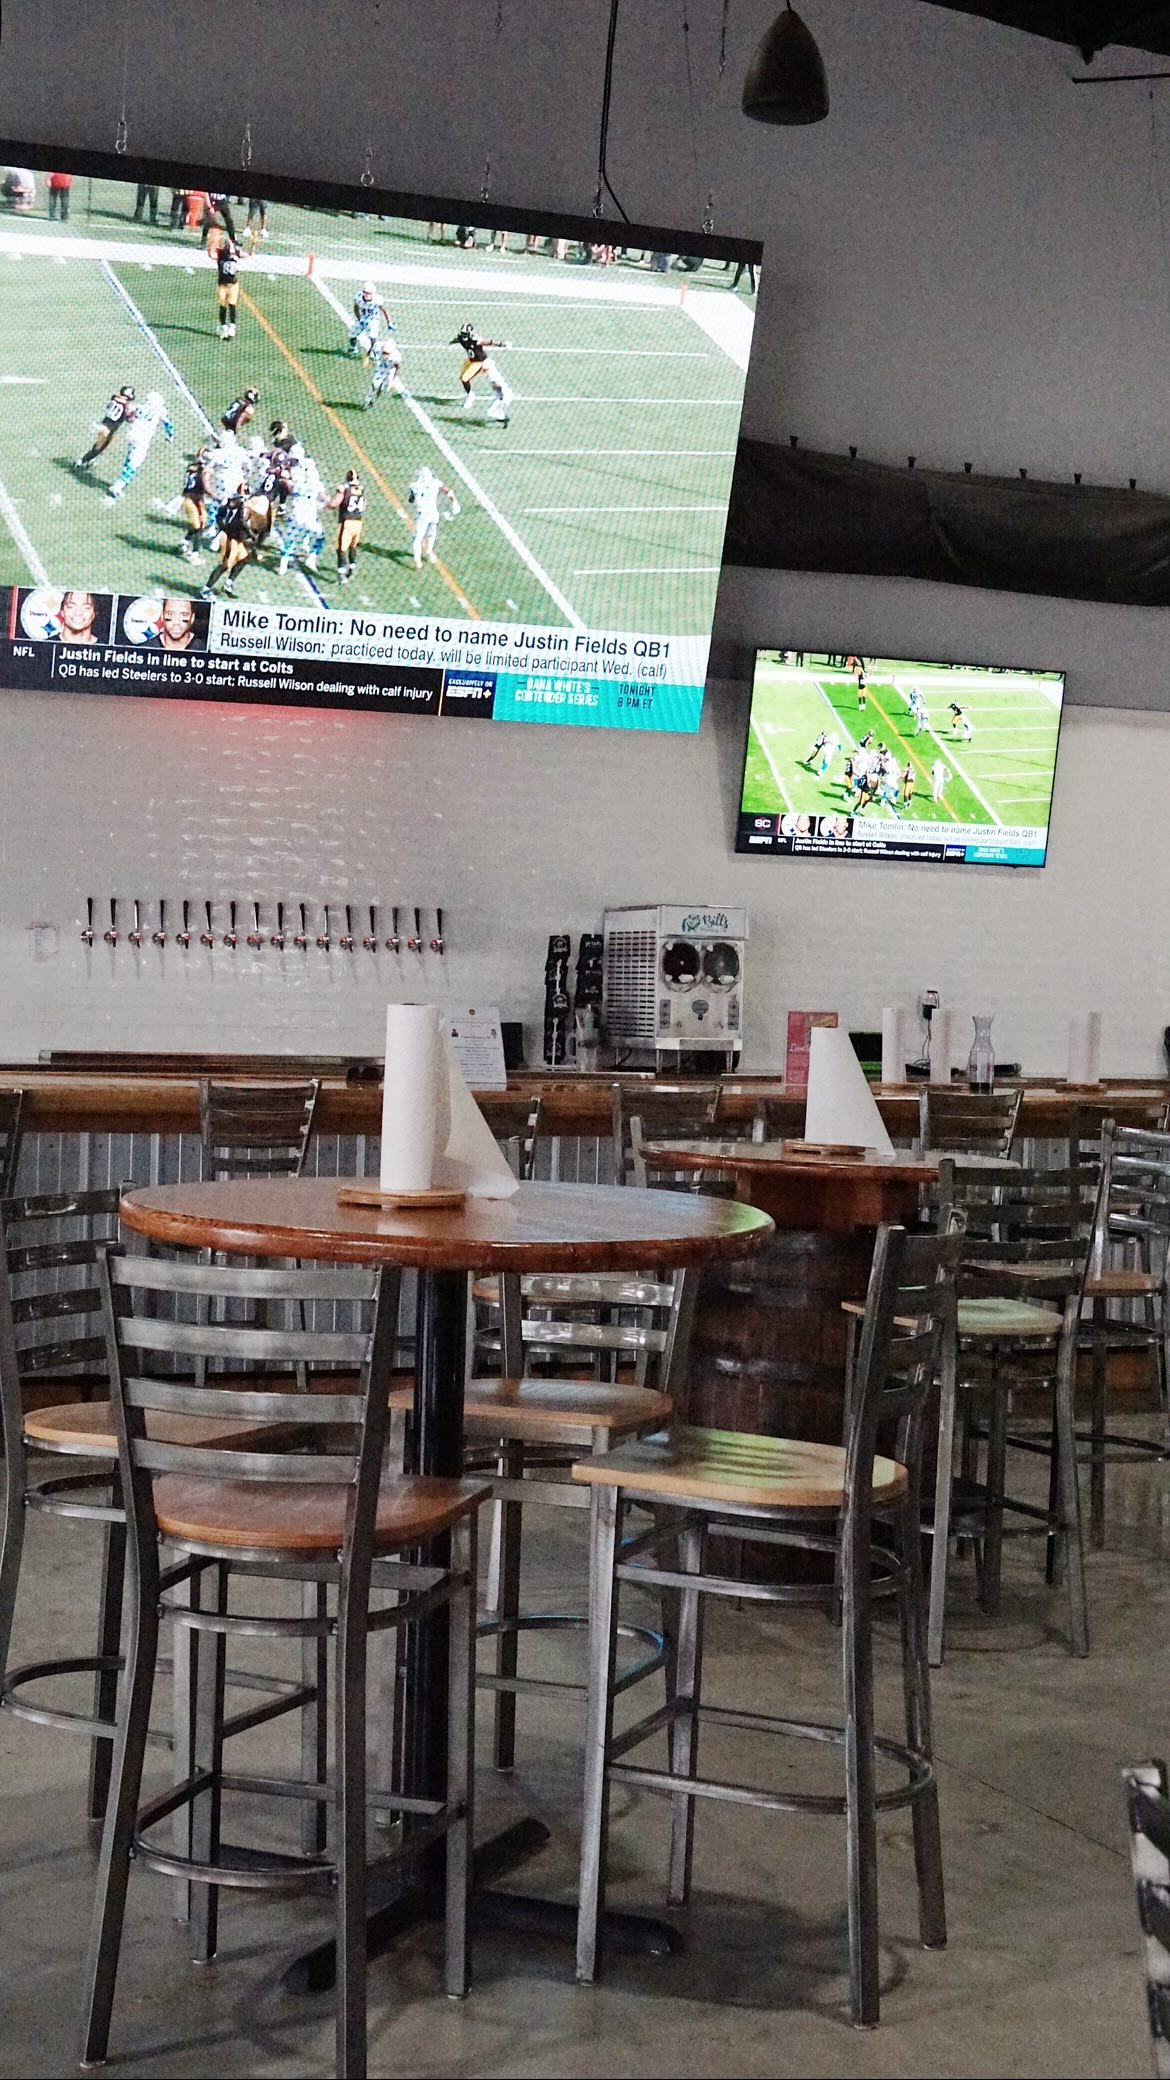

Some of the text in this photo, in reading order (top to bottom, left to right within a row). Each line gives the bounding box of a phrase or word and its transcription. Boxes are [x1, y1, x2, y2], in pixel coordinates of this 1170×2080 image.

[223, 609, 670, 659] Mike Tomlin: No need to name Justin Fields QB1
[13, 645, 35, 657] NFL
[221, 632, 668, 680] Russell Wilson: practiced today, will be limited participant Wed. (calf)
[59, 647, 294, 675] Justin Fields in line to start at Colts
[59, 663, 433, 701] QB has led Steelers to 3-0 start; Russell Wilson dealing with calf injury
[448, 678, 483, 687] EXCLUSIVELY
[527, 678, 550, 691] DANA
[618, 684, 656, 697] TONIGHT
[515, 689, 598, 707] CONTENDER SERIES
[617, 697, 653, 709] 8 PM ET
[754, 818, 771, 828] SC
